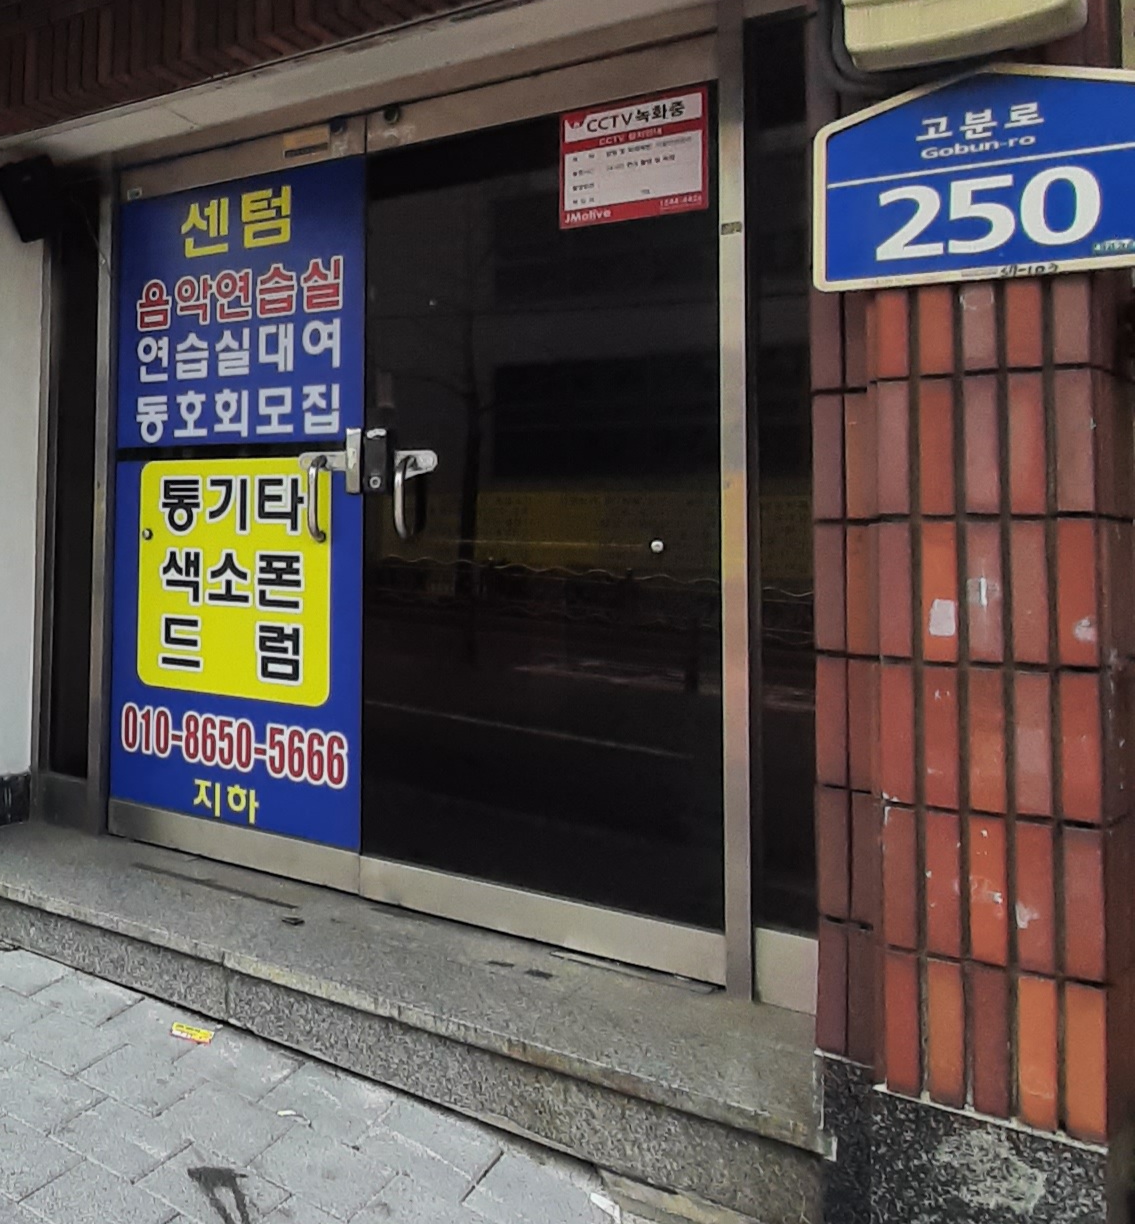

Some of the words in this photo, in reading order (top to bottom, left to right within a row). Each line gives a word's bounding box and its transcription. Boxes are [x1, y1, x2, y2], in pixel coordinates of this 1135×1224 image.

[915, 102, 1045, 142] 고분로
[920, 135, 1037, 160] Gobun-ro
[181, 184, 292, 259] 센텀
[875, 165, 1102, 262] 250
[136, 254, 344, 333] 음악연습실
[136, 317, 342, 384] 연습실대여
[135, 382, 341, 445] 동호회모집
[159, 473, 308, 536] 통기타
[158, 545, 304, 614] 색소폰
[157, 613, 304, 687] 드럼
[120, 701, 349, 791] 010-8650-5666
[192, 777, 260, 826] 지하
